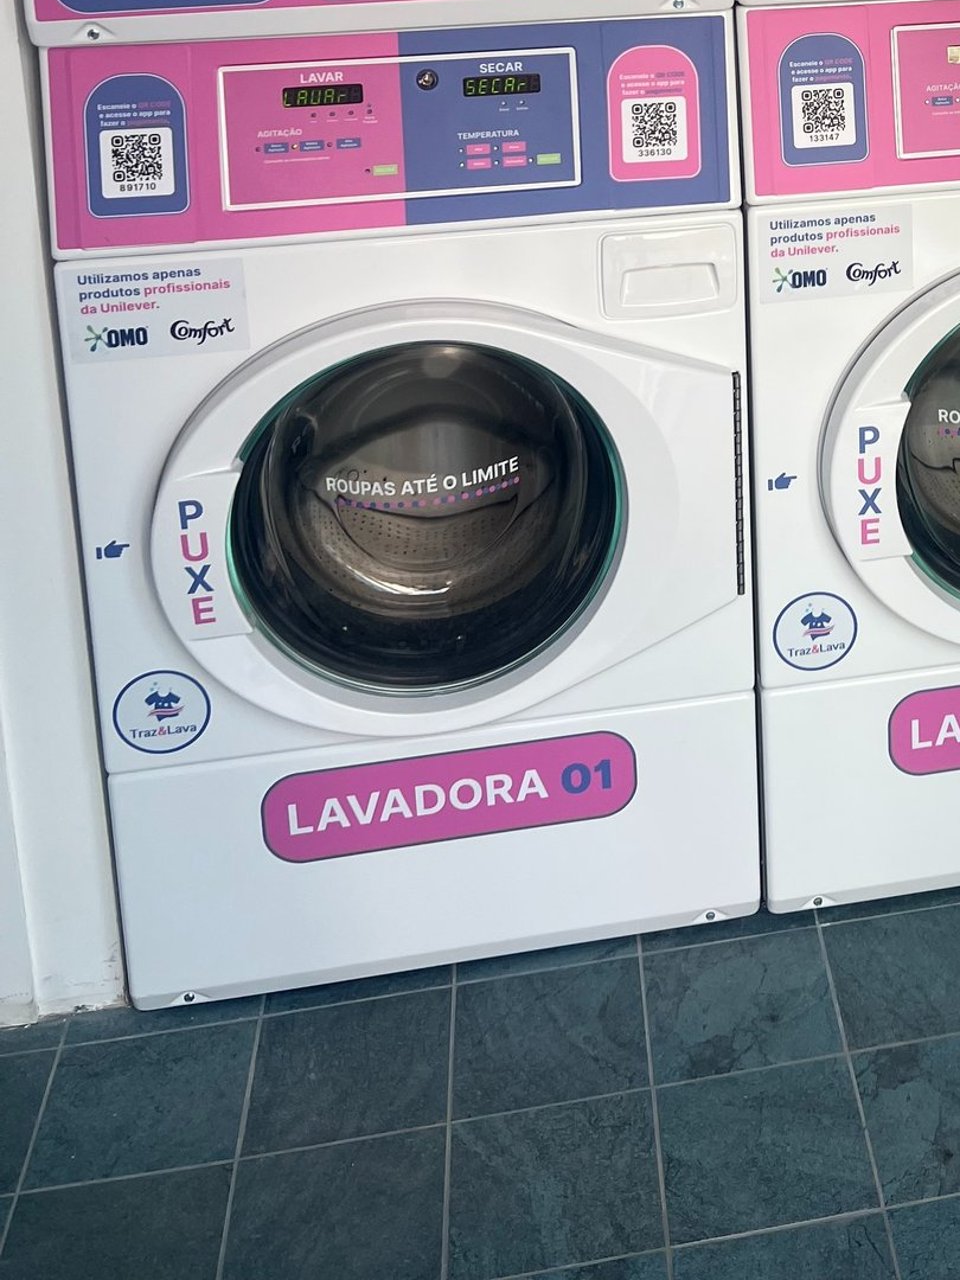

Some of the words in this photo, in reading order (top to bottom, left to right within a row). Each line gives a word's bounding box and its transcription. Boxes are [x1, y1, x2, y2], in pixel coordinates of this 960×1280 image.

[479, 61, 523, 74] SECAR
[300, 71, 344, 84] LAVAR
[456, 128, 520, 141] TEMPERATURA
[809, 132, 840, 142] 133147
[119, 182, 157, 192] 891710
[769, 218, 832, 231] Utilizamos
[833, 214, 876, 227] apenas
[770, 232, 824, 247] produtos
[826, 225, 900, 241] profissionais
[770, 247, 786, 258] da
[787, 244, 839, 257] Unilever.
[76, 272, 149, 286] Utilizamos
[151, 268, 202, 282] apenas
[790, 270, 826, 288] OMO
[846, 261, 901, 286] Comfort
[78, 287, 141, 303] produtos
[144, 281, 230, 297] profissionais
[80, 304, 98, 315] da
[100, 301, 160, 314] Unilever.
[105, 327, 148, 347] OMO
[170, 319, 234, 345] Comfort
[326, 477, 396, 496] ROUPAS
[401, 474, 437, 495] ATÉ
[442, 475, 457, 490] O
[462, 457, 518, 487] LIMITE
[858, 426, 882, 544] PUXE
[178, 500, 216, 625] PUXE
[787, 642, 846, 658] Traz&Lava
[129, 724, 197, 739] Traz&Lava
[288, 769, 548, 835] LAVADORA
[561, 759, 611, 794] 01
